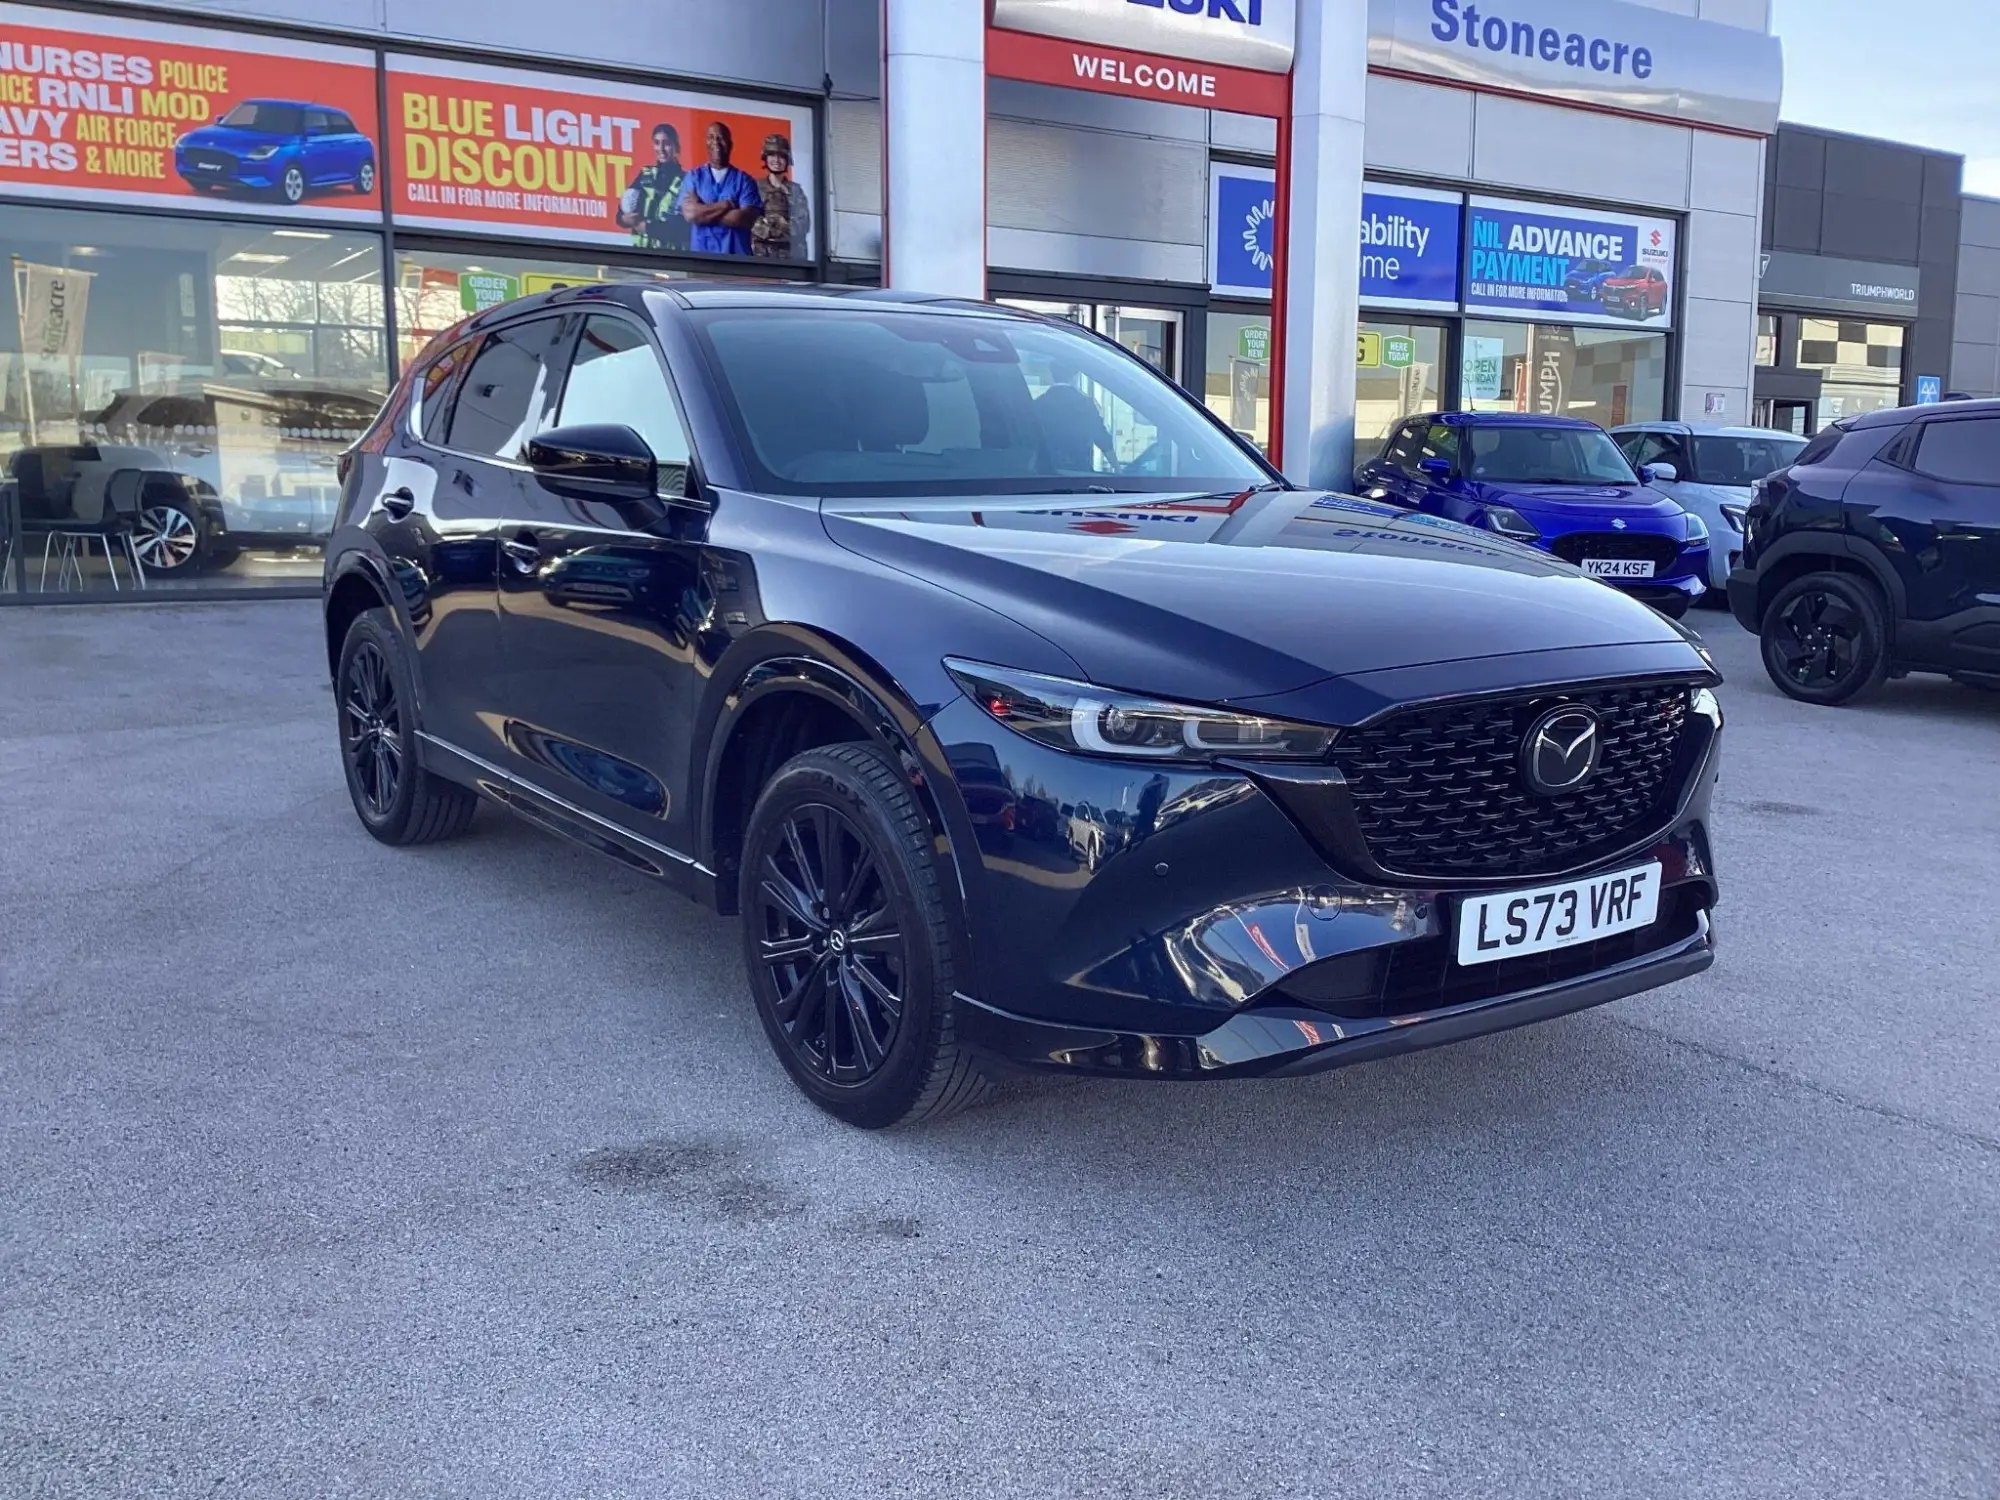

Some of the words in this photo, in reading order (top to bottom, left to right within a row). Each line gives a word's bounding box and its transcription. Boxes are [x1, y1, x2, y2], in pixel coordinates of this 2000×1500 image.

[1431, 0, 1653, 80] Stoneacre
[159, 59, 229, 94] POLICE
[1073, 53, 1217, 97] WELCOME
[38, 77, 134, 115] RNLI
[141, 88, 210, 122] MOD
[76, 112, 112, 144] AIR
[114, 116, 178, 150] FORCE
[403, 91, 496, 138] BLUE
[503, 103, 641, 153] LIGHT
[0, 137, 78, 172] ERS
[86, 145, 102, 174] &
[104, 147, 166, 179] MORE
[405, 133, 633, 199] DISCOUNT
[407, 182, 439, 203] CALL
[440, 185, 457, 205] IN
[458, 186, 483, 207] FOR
[484, 188, 522, 211] MORE
[522, 191, 607, 218] INFORMATION
[1361, 213, 1430, 258] ability
[1472, 219, 1503, 249] NIL
[1507, 223, 1623, 262] ADVANCE
[1641, 247, 1669, 258] SUZUKI
[469, 275, 508, 290] ORDER
[1472, 248, 1570, 287] PAYMENT
[473, 287, 505, 302] YOUR
[1471, 281, 1487, 296] CALL
[1487, 283, 1495, 297] IN
[1495, 283, 1508, 298] FOR
[1508, 284, 1526, 300] MORE
[1245, 329, 1268, 340] ORDER
[1247, 339, 1265, 349] YOUR
[1389, 340, 1409, 352] HERE
[1247, 348, 1264, 358] NEW
[1387, 350, 1410, 362] TODAY
[1464, 359, 1497, 373] OPEN
[1463, 372, 1497, 385] SUNDAY
[1587, 561, 1620, 575] YK24
[1623, 562, 1649, 575] KSF
[1477, 889, 1578, 951] LS73
[1589, 871, 1648, 930] VRF
